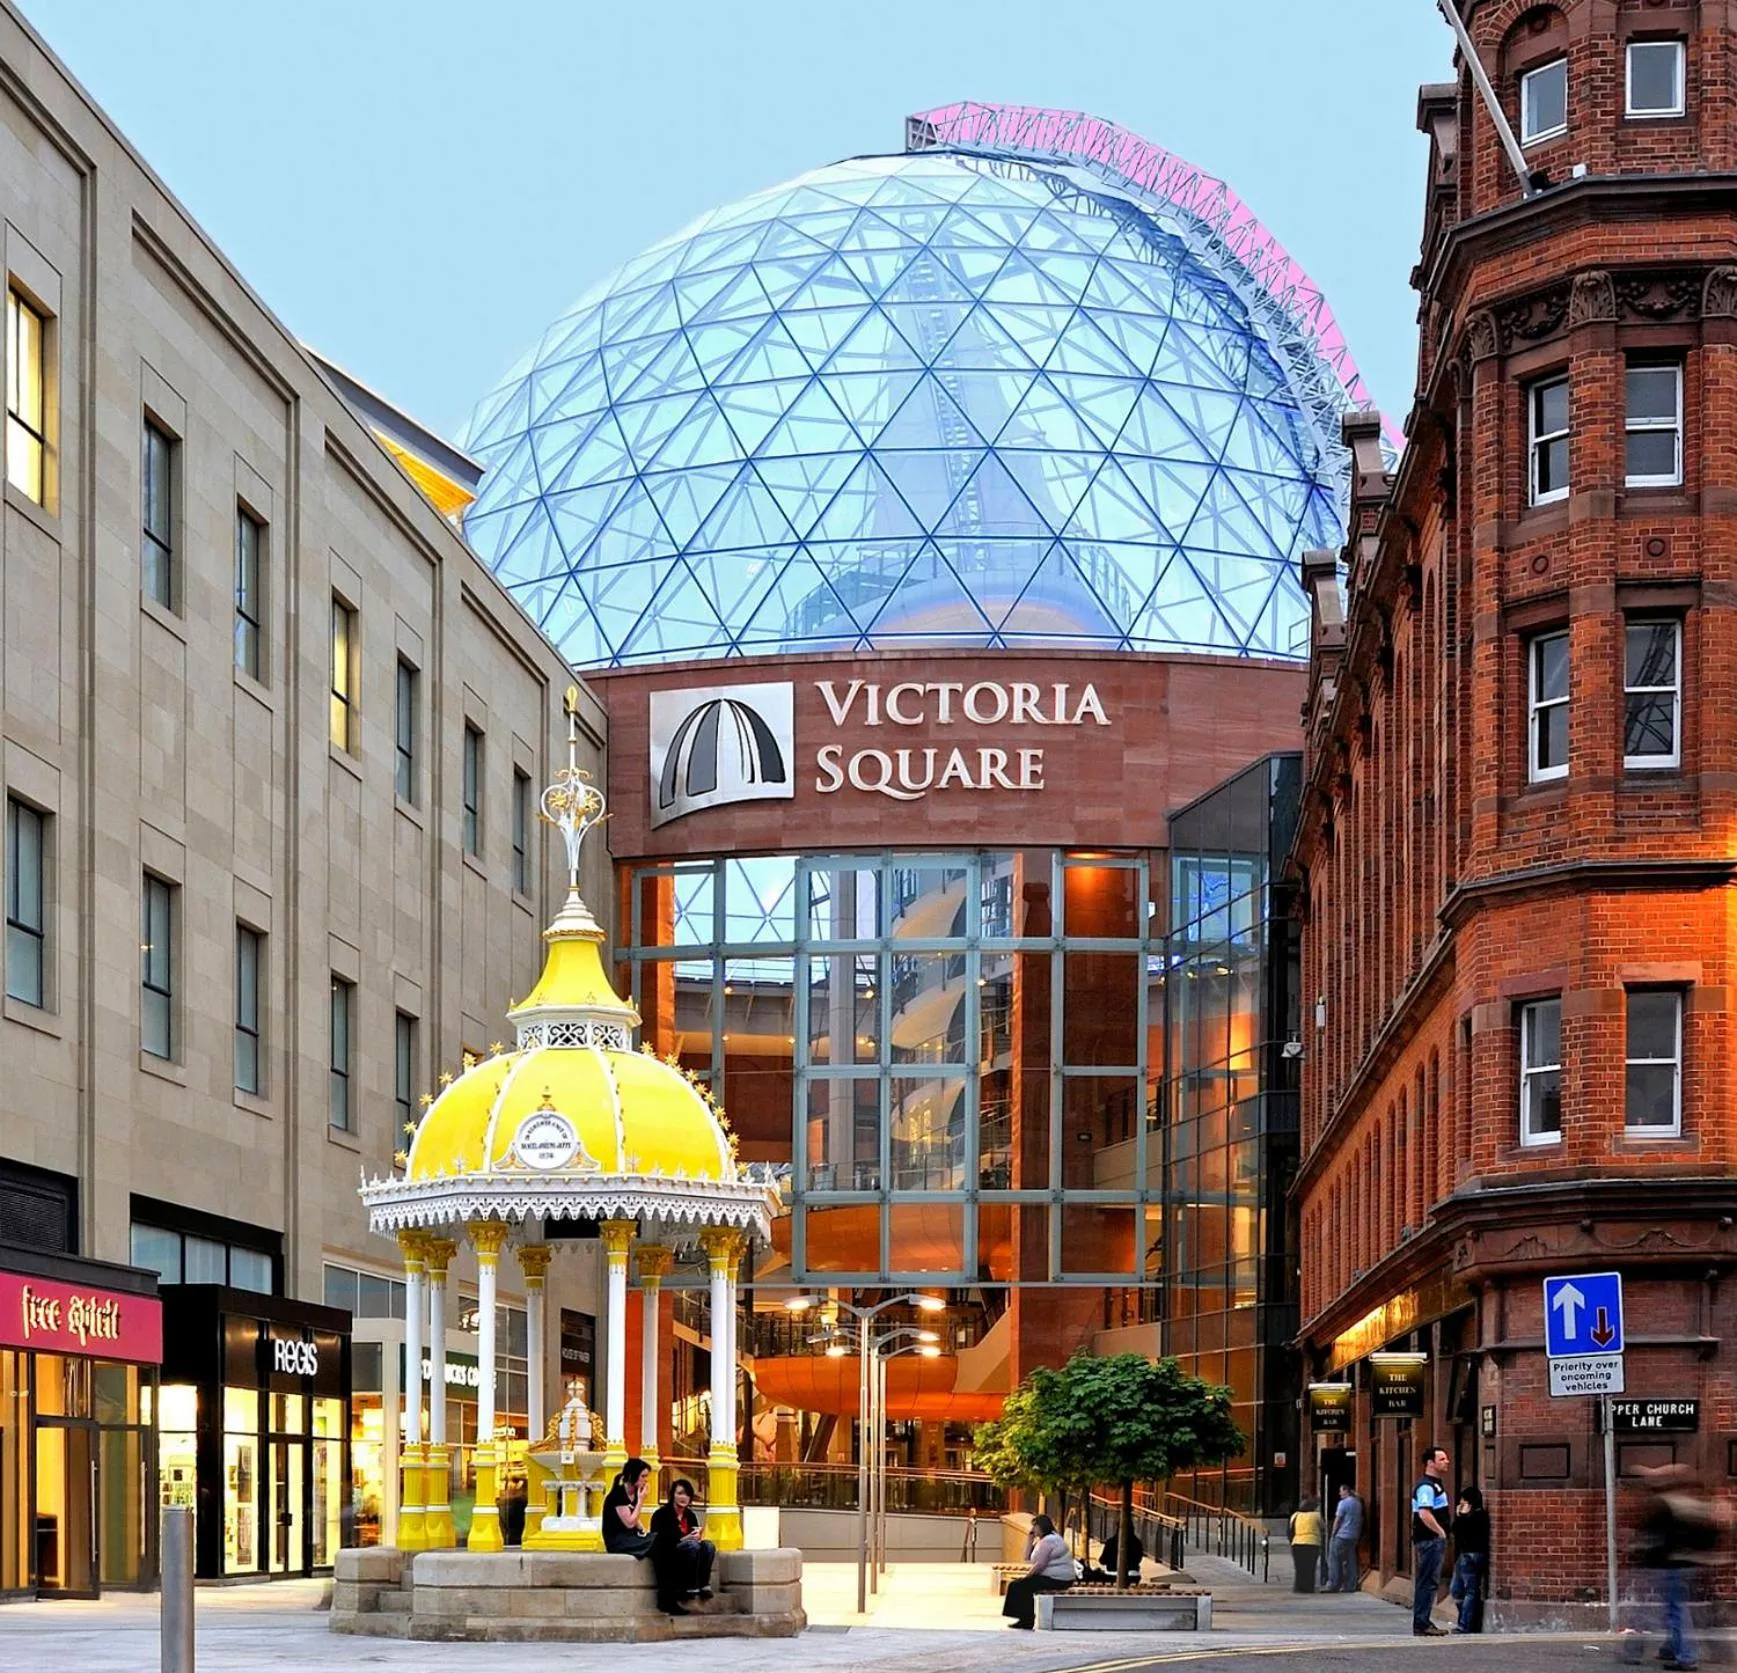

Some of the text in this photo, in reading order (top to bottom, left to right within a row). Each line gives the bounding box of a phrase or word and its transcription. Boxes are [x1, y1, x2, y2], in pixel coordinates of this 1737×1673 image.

[814, 679, 1112, 727] VICTORIA
[816, 744, 1045, 800] SQUARE
[1553, 1361, 1618, 1372] Priority over
[1389, 1373, 1408, 1382] THE
[1561, 1371, 1612, 1382] oncoming
[1379, 1386, 1416, 1395] KITCHEN
[1565, 1382, 1608, 1391] vehicles
[1388, 1399, 1407, 1408] BAR
[1646, 1404, 1695, 1415] CHURCH
[1632, 1416, 1663, 1427] LANE
